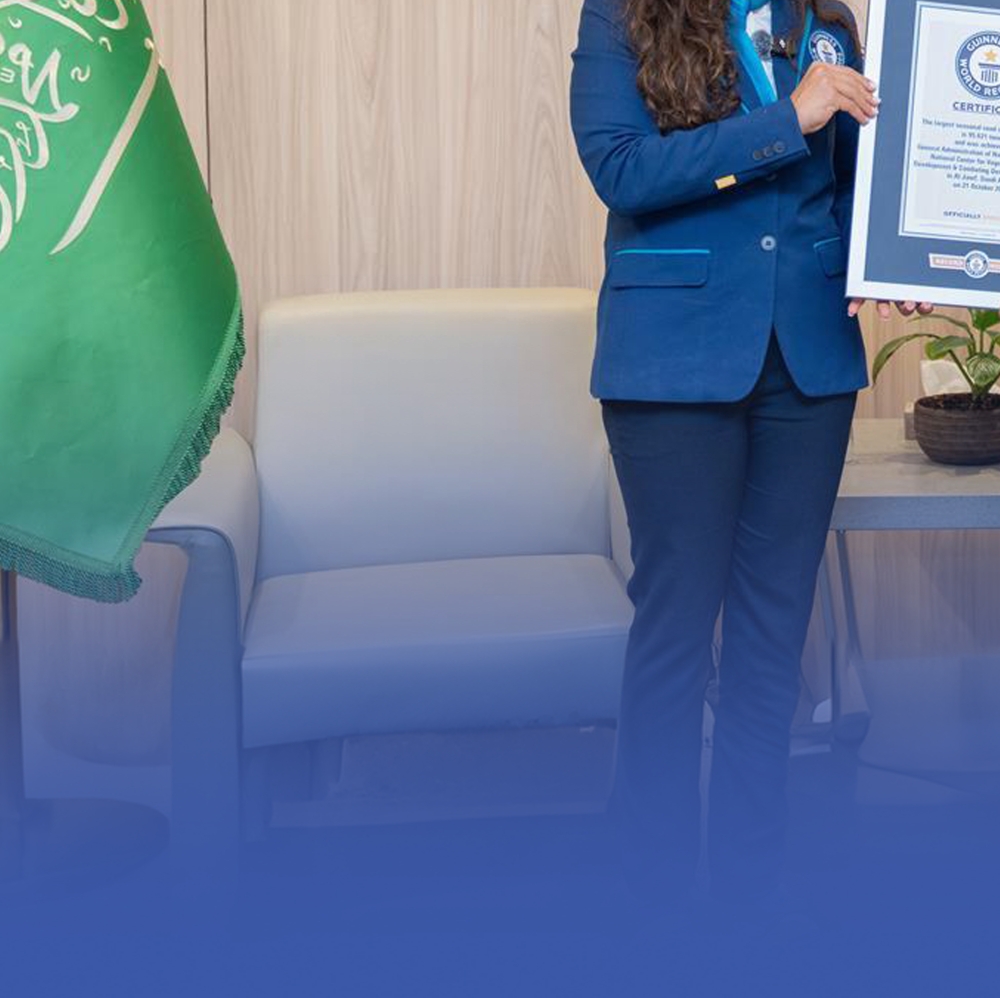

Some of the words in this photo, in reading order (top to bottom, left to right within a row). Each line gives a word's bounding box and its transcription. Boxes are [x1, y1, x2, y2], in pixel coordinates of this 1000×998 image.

[960, 58, 982, 93] WORLD
[934, 120, 954, 128] largest
[930, 153, 955, 161] National
[980, 175, 996, 183] Saudi
[971, 183, 994, 192] October
[943, 210, 981, 219] OFFICIALLY
